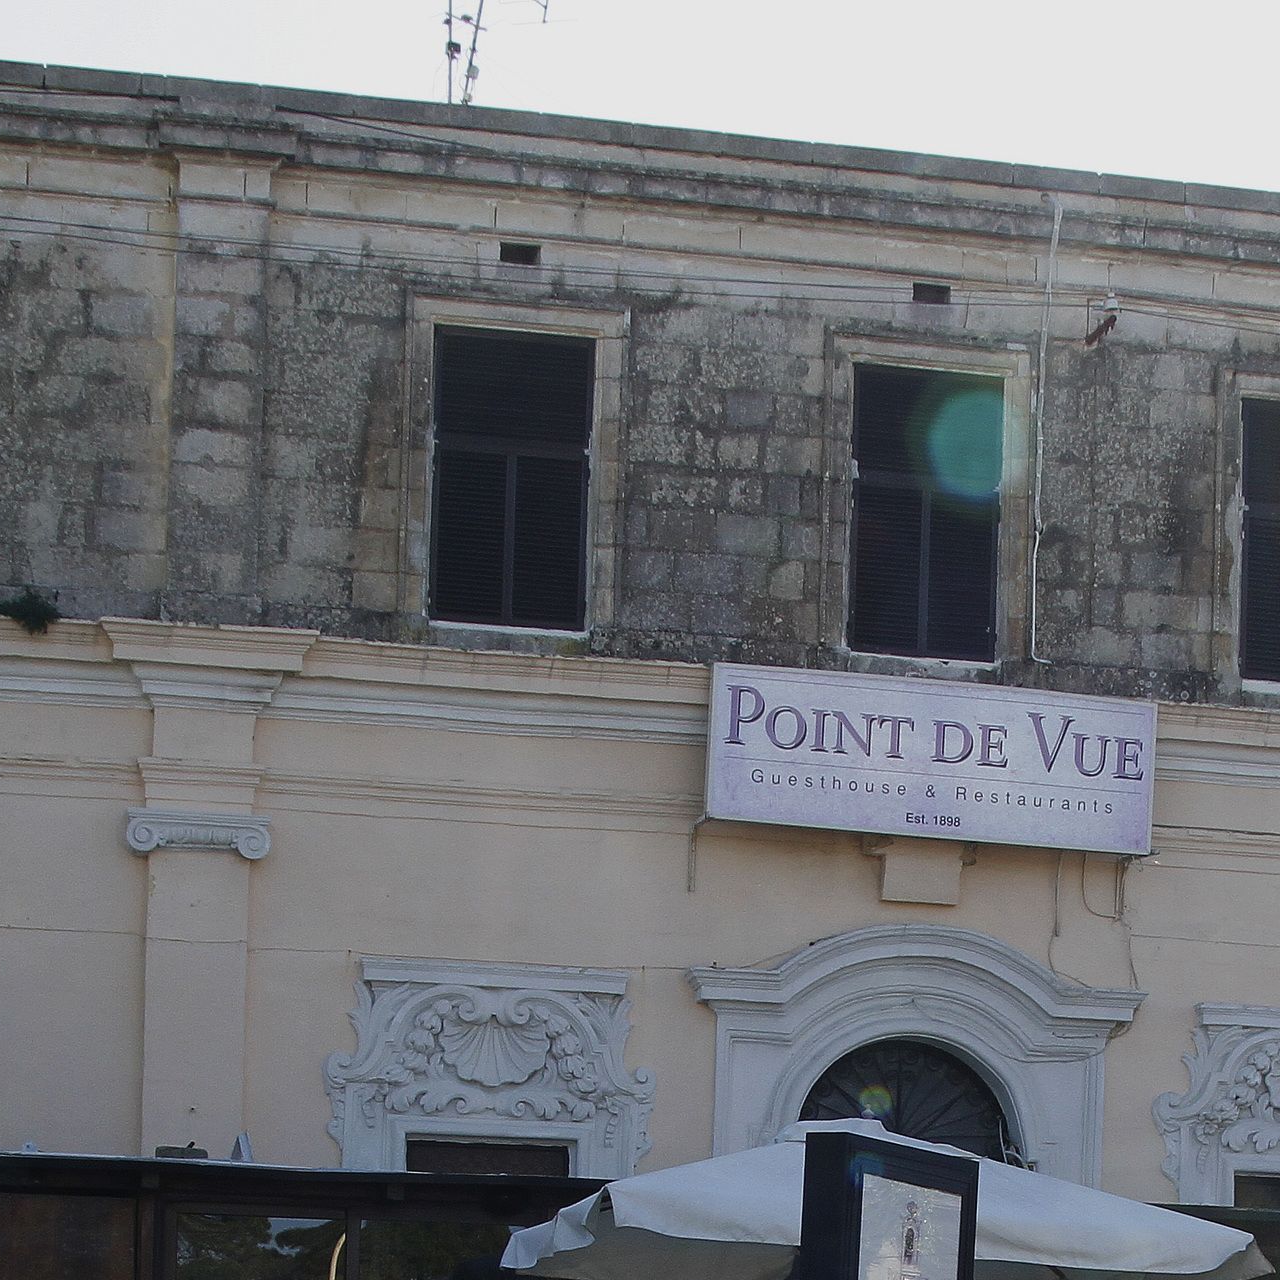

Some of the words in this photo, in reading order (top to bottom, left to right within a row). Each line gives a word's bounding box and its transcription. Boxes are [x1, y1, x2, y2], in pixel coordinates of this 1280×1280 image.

[724, 684, 915, 760] POINT
[931, 719, 1009, 769] DE
[1027, 711, 1145, 781] VUE
[751, 768, 907, 797] Guesthouse
[925, 784, 937, 799] &
[955, 786, 1114, 815] Restaurants
[905, 812, 929, 826] Est.
[932, 814, 961, 828] 1898
